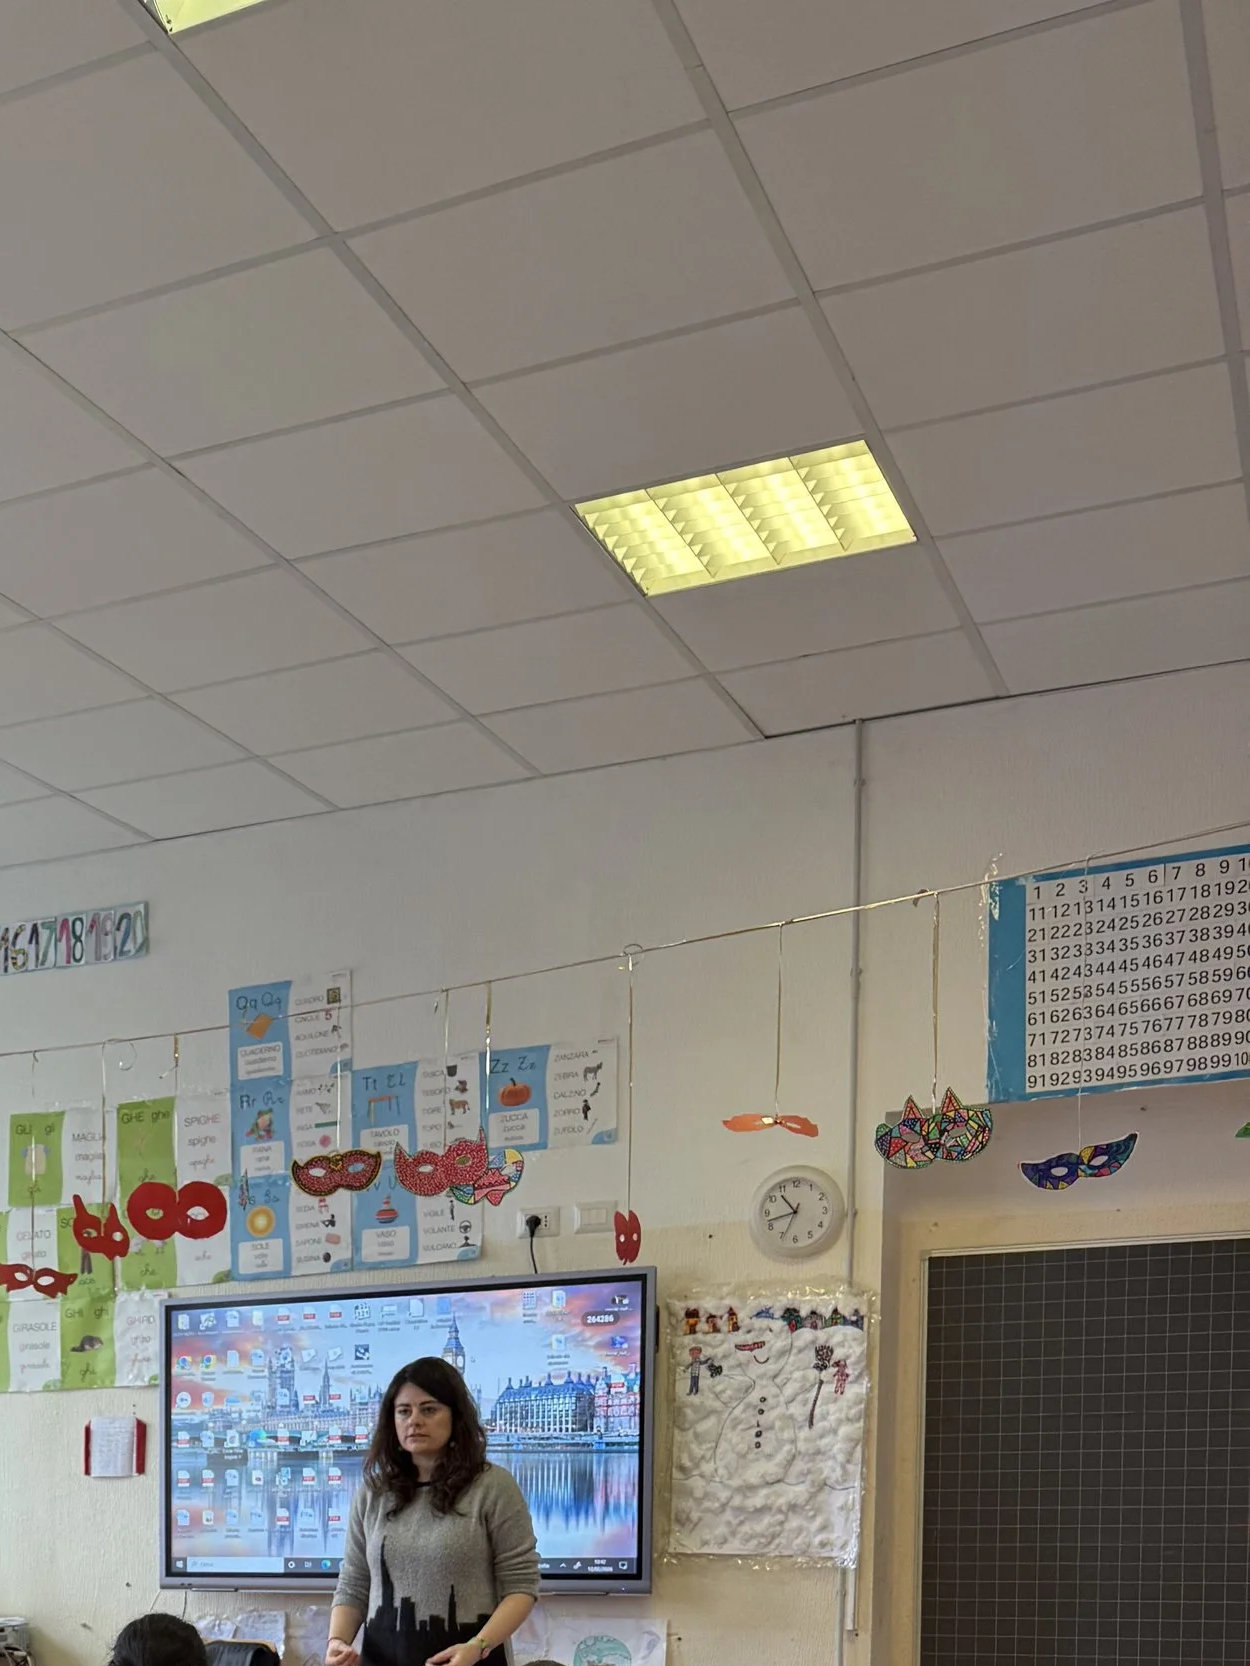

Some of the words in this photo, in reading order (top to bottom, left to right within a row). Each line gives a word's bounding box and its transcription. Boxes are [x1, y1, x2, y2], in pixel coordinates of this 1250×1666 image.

[1033, 886, 1040, 899] 1
[1055, 883, 1064, 896] 2
[1078, 880, 1087, 893] 3
[1101, 877, 1110, 889] 4
[1125, 873, 1134, 887] 5
[1148, 870, 1158, 883] 6
[1172, 866, 1181, 880] 7
[1195, 863, 1205, 877] 8
[1219, 860, 1229, 873] 9
[1030, 907, 1044, 920] 11
[1054, 904, 1070, 918] 12
[1074, 901, 1093, 915] 13
[1097, 897, 1115, 911] 14
[1120, 894, 1139, 908] 15
[1144, 891, 1163, 905] 16
[1167, 887, 1186, 902] 17
[1191, 884, 1210, 899] 18
[1215, 881, 1234, 896] 19
[29, 921, 55, 968] 17
[58, 917, 84, 964] 18
[89, 912, 113, 961] 19
[116, 911, 145, 956] 20
[1028, 928, 1045, 942] 21
[1051, 925, 1070, 939] 22
[1073, 922, 1093, 936] 23
[1096, 918, 1115, 933] 24
[1119, 915, 1139, 930] 25
[1143, 912, 1162, 927] 26
[1166, 909, 1185, 924] 27
[1189, 906, 1210, 921] 28
[1213, 903, 1234, 918] 29
[1029, 949, 1045, 963] 31
[1051, 946, 1070, 960] 32
[1074, 943, 1093, 957] 33
[1096, 940, 1115, 954] 34
[1119, 936, 1138, 951] 35
[1143, 933, 1162, 948] 36
[1166, 930, 1185, 945] 37
[1189, 928, 1209, 942] 38
[1213, 925, 1233, 939] 39
[1028, 970, 1045, 983] 41
[1051, 967, 1070, 980] 42
[1073, 964, 1092, 977] 43
[1096, 961, 1114, 975] 44
[1119, 958, 1138, 972] 45
[1142, 955, 1162, 969] 46
[1165, 952, 1185, 966] 47
[1189, 949, 1209, 963] 48
[1213, 946, 1233, 960] 49
[1029, 991, 1045, 1004] 51
[1051, 988, 1070, 1002] 52
[1073, 985, 1092, 999] 53
[1096, 982, 1114, 996] 54
[1119, 979, 1139, 994] 55
[1142, 976, 1161, 991] 56
[1165, 974, 1184, 988] 57
[1189, 971, 1208, 985] 58
[1212, 968, 1233, 982] 59
[121, 1111, 144, 1124] GHE
[184, 1114, 221, 1127] SPIGHE
[793, 1180, 800, 1188] 12
[819, 1193, 824, 1201] 2
[793, 1235, 798, 1243] 6
[13, 1322, 57, 1333] GIRASOLE
